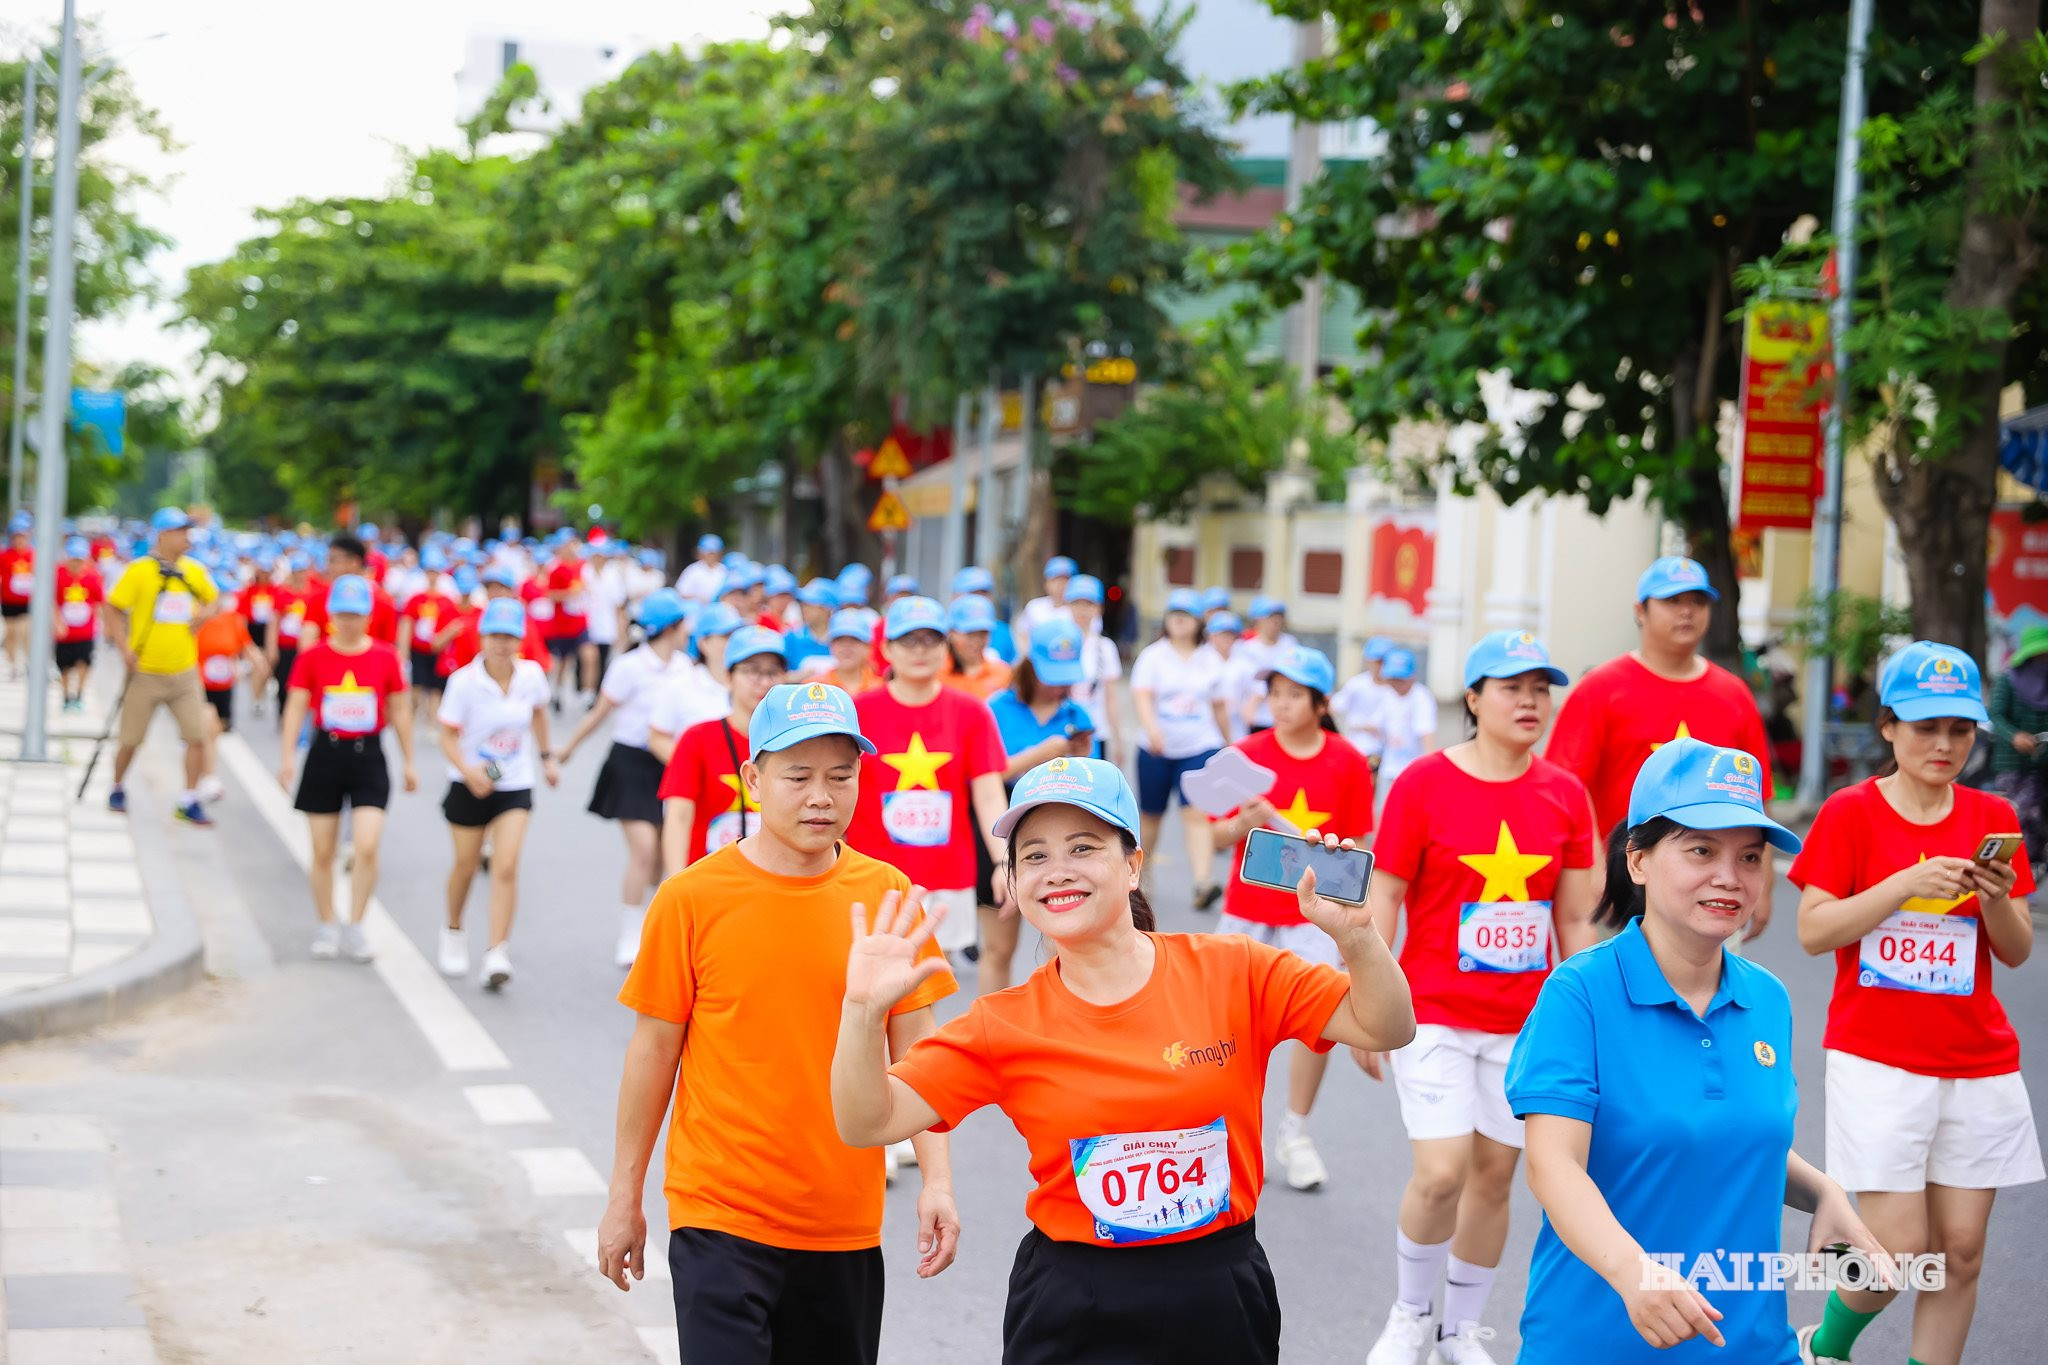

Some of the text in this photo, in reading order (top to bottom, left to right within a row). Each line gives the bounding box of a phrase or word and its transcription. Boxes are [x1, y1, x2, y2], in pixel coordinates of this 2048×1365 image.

[1477, 924, 1536, 949] 0835
[1879, 935, 1957, 967] 0844
[1123, 1139, 1145, 1152] GIẢI
[1148, 1141, 1178, 1149] CHẠY
[1102, 1156, 1207, 1207] 0764
